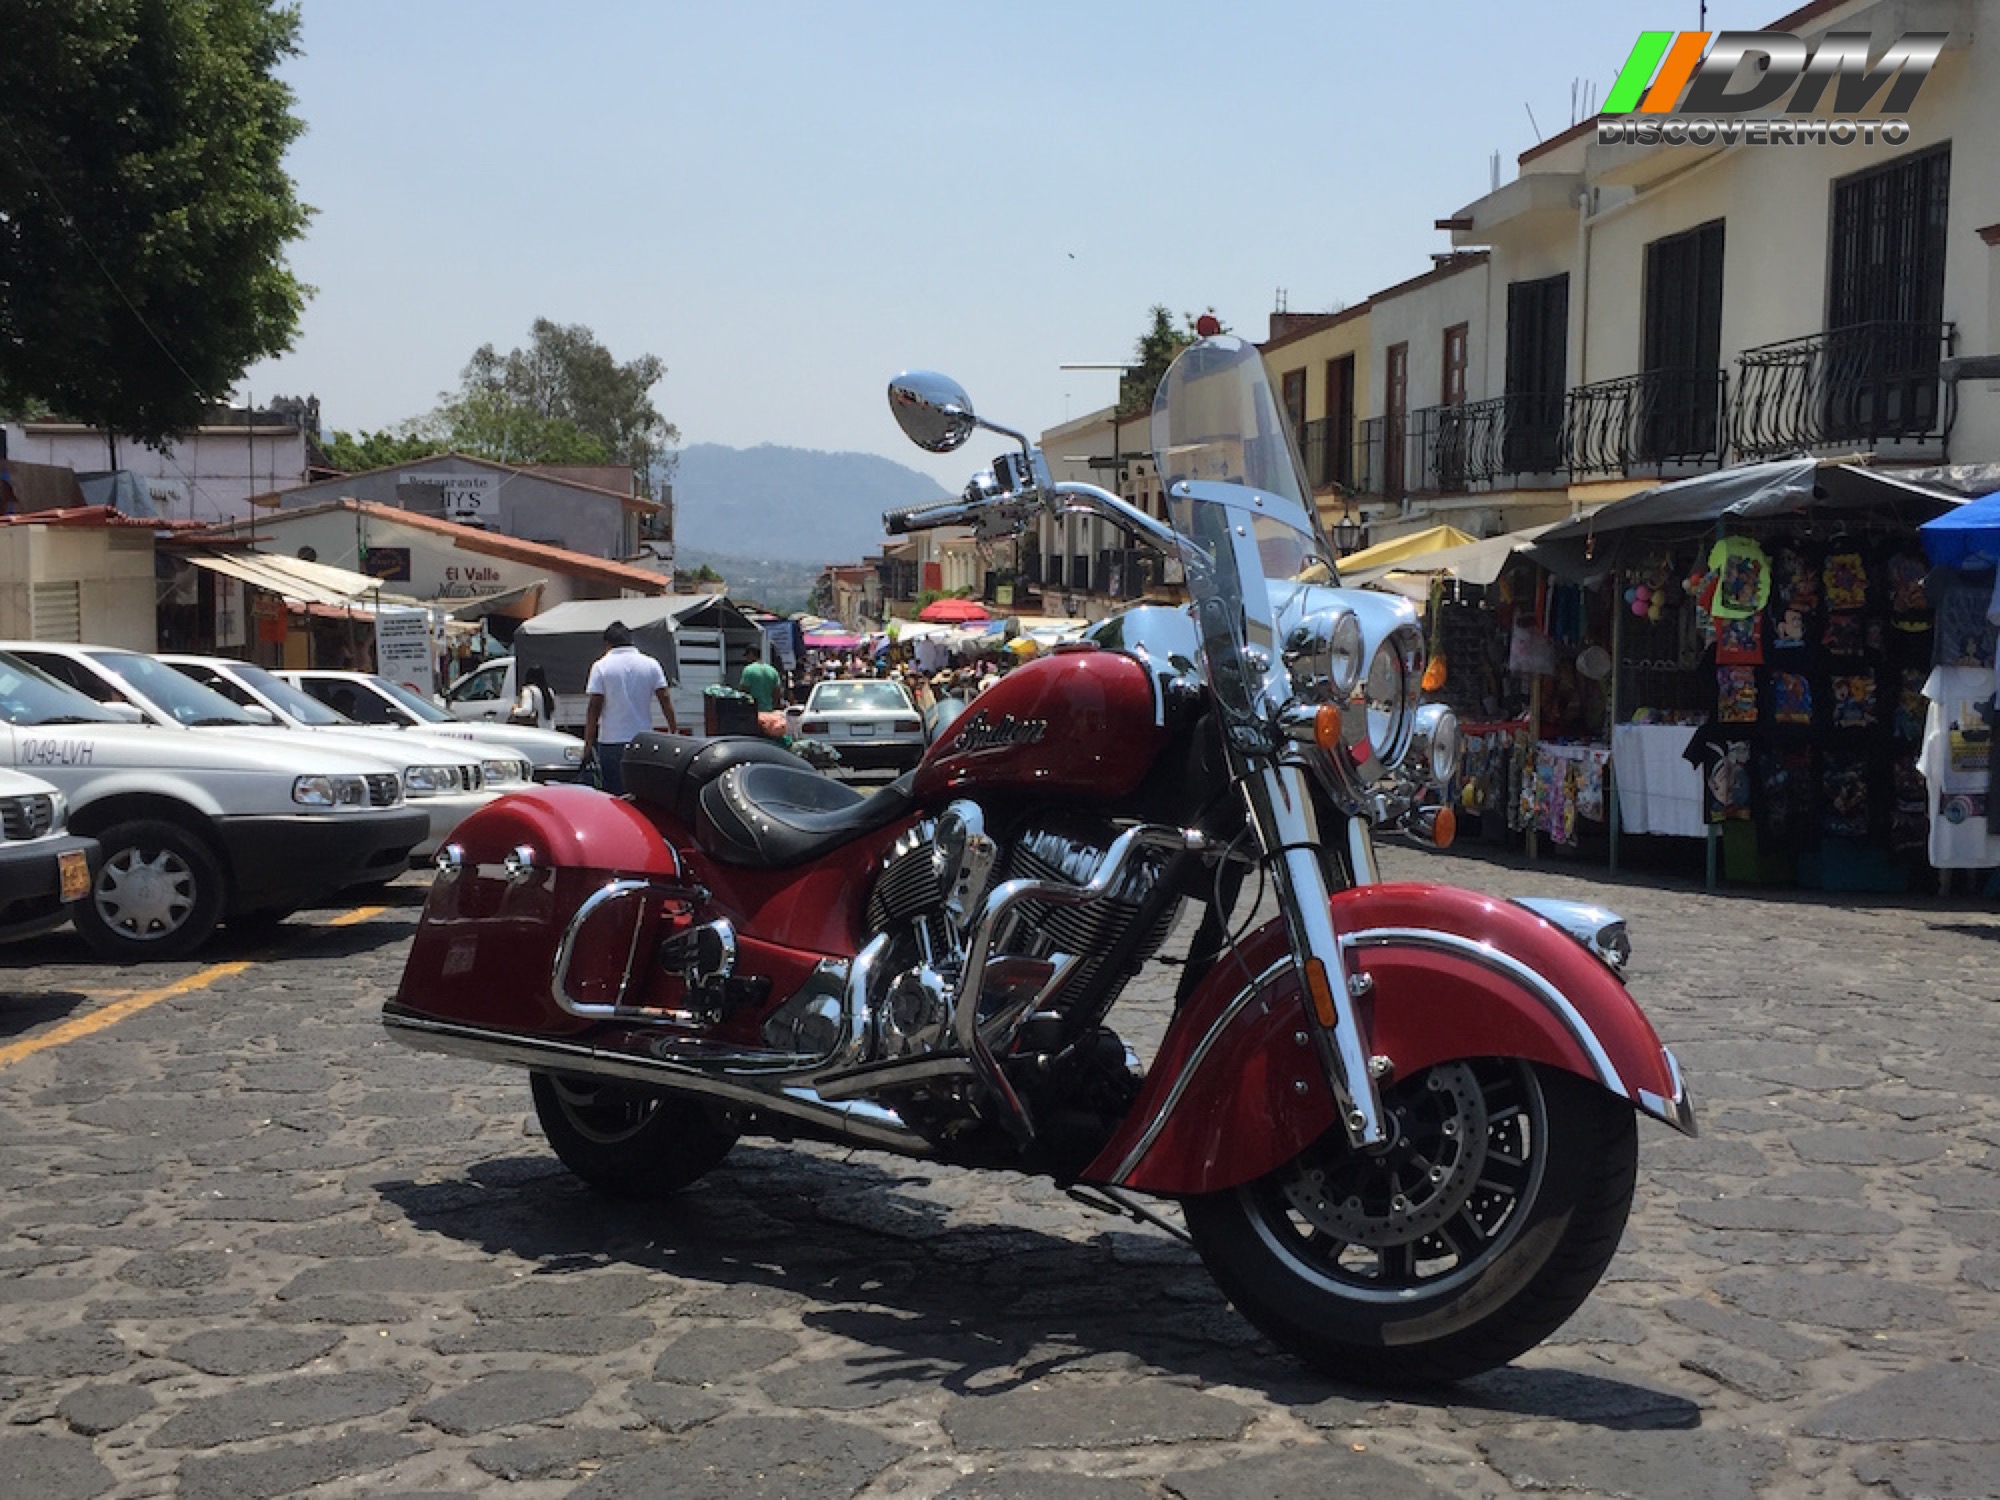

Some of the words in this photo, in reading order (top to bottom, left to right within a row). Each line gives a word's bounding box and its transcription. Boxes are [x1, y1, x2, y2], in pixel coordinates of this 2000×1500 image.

[445, 566, 459, 581] El
[464, 566, 501, 581] Valle
[22, 738, 95, 765] 1049-LVH
